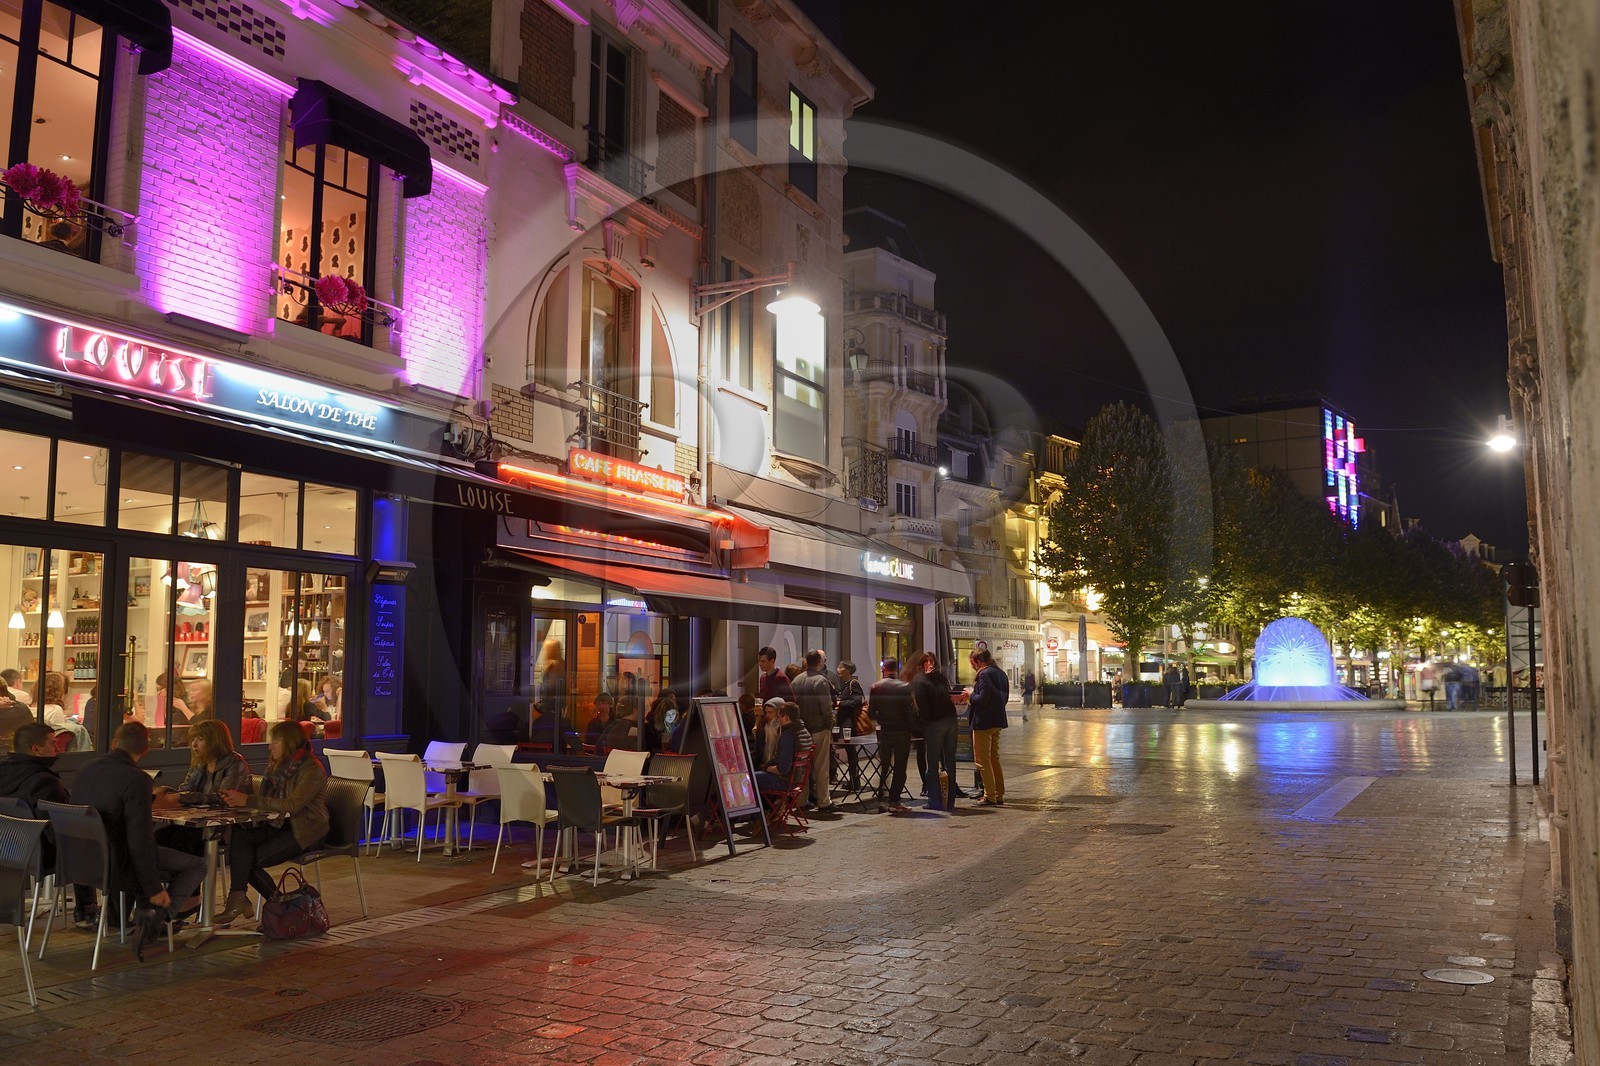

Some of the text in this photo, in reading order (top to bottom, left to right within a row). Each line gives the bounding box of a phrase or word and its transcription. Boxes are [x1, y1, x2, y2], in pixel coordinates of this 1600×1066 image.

[256, 388, 318, 416] SALON
[318, 403, 343, 423] DE
[616, 464, 688, 495] BRASSERIE
